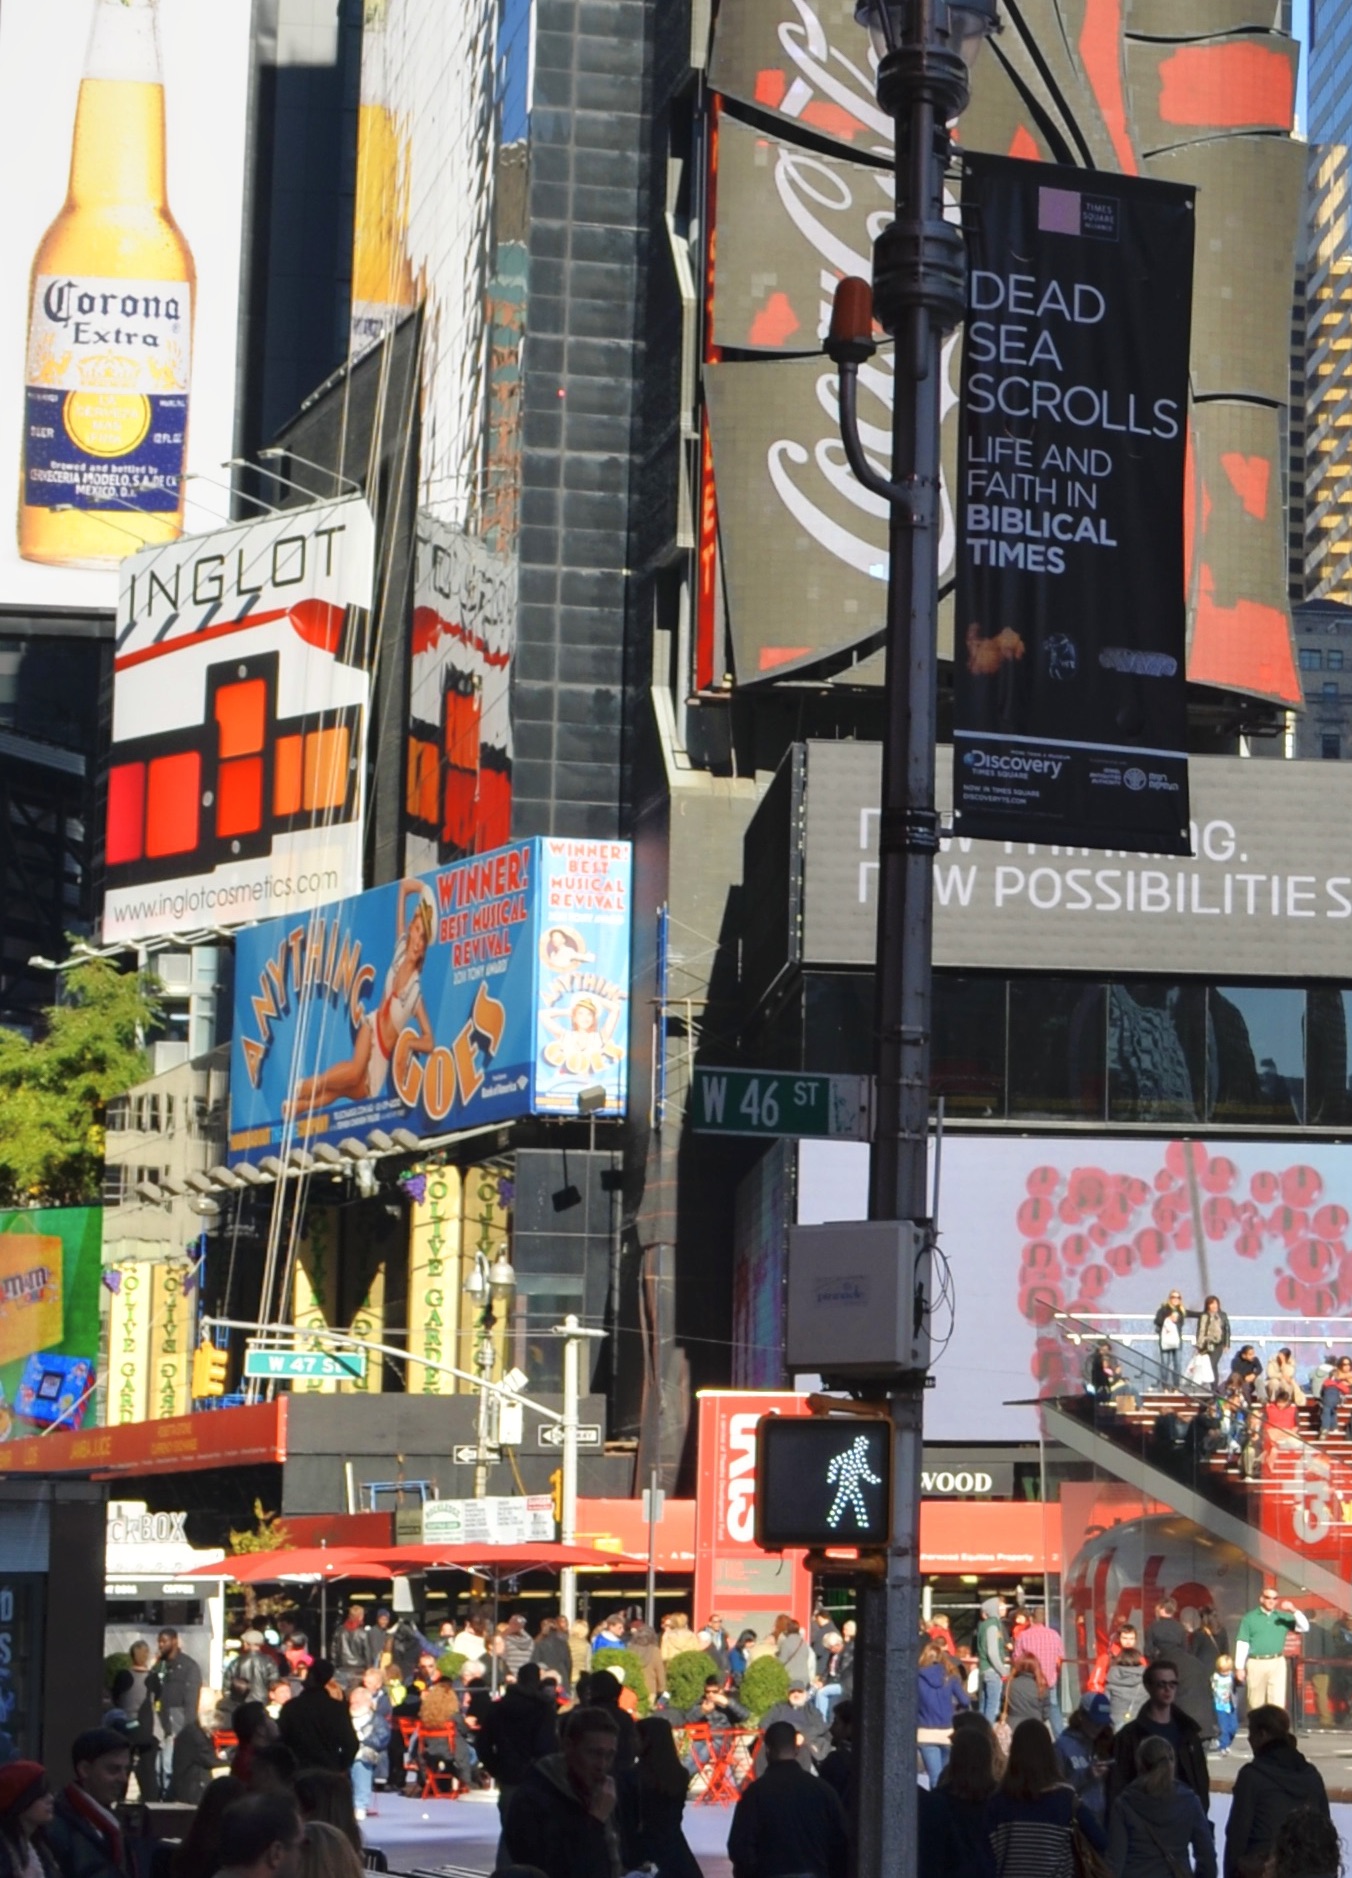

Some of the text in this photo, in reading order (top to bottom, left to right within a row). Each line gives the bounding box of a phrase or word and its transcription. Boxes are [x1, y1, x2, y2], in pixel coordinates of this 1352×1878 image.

[44, 279, 180, 328] Corona
[971, 269, 1105, 324] DEAD
[73, 322, 160, 348] Extra
[967, 321, 1062, 371] SEA
[966, 375, 1179, 440] SCROLLS
[967, 436, 1113, 477] LIFE AND
[967, 470, 1098, 510] FAITH IN
[967, 505, 1118, 547] BIBLICAL
[129, 525, 347, 624] INGLOT
[968, 538, 1066, 575] TIMES
[972, 749, 1063, 780] Discovery
[972, 767, 1029, 780] TIMES SQUARE
[963, 784, 1040, 798] NOW TIMES SQUARE
[551, 842, 628, 860] WINNER!
[568, 860, 609, 874] BEST
[113, 867, 339, 924] www.inglotcosmetics.com
[436, 846, 530, 913] WINNER!
[551, 877, 625, 893] MUSICAL
[439, 895, 528, 945] BEST MUSICAL
[551, 893, 625, 911] REVIVAL
[452, 927, 512, 969] REVIVAL
[392, 980, 506, 1121] GOES
[701, 1076, 819, 1127] W 46 ST
[427, 1181, 448, 1277] OLIVE
[123, 1276, 140, 1353] OLIVE
[268, 1356, 287, 1374] W
[290, 1355, 315, 1374] 47
